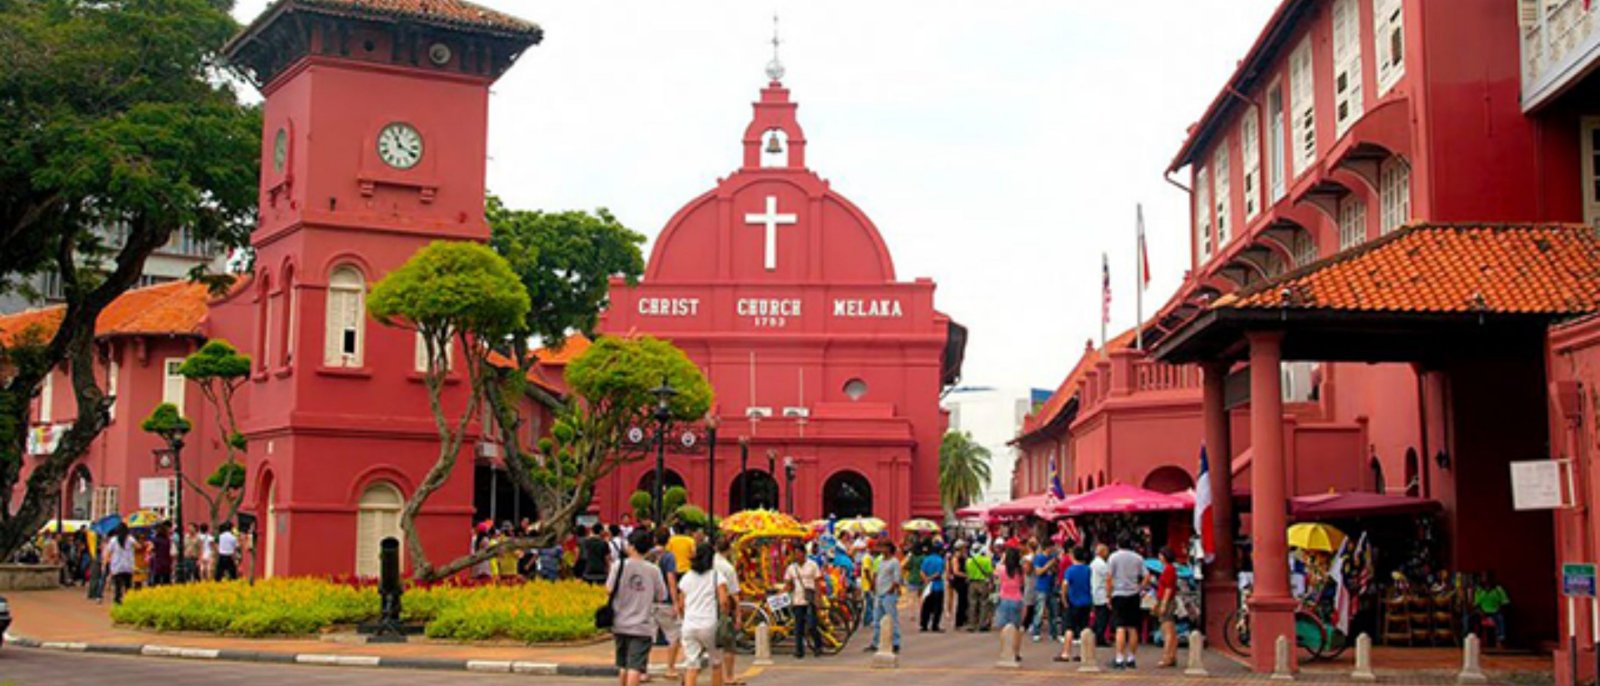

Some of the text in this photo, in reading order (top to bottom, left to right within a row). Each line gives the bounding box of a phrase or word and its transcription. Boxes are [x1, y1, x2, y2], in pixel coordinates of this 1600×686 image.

[638, 298, 903, 316] CHRIST CHURCH MELAKA
